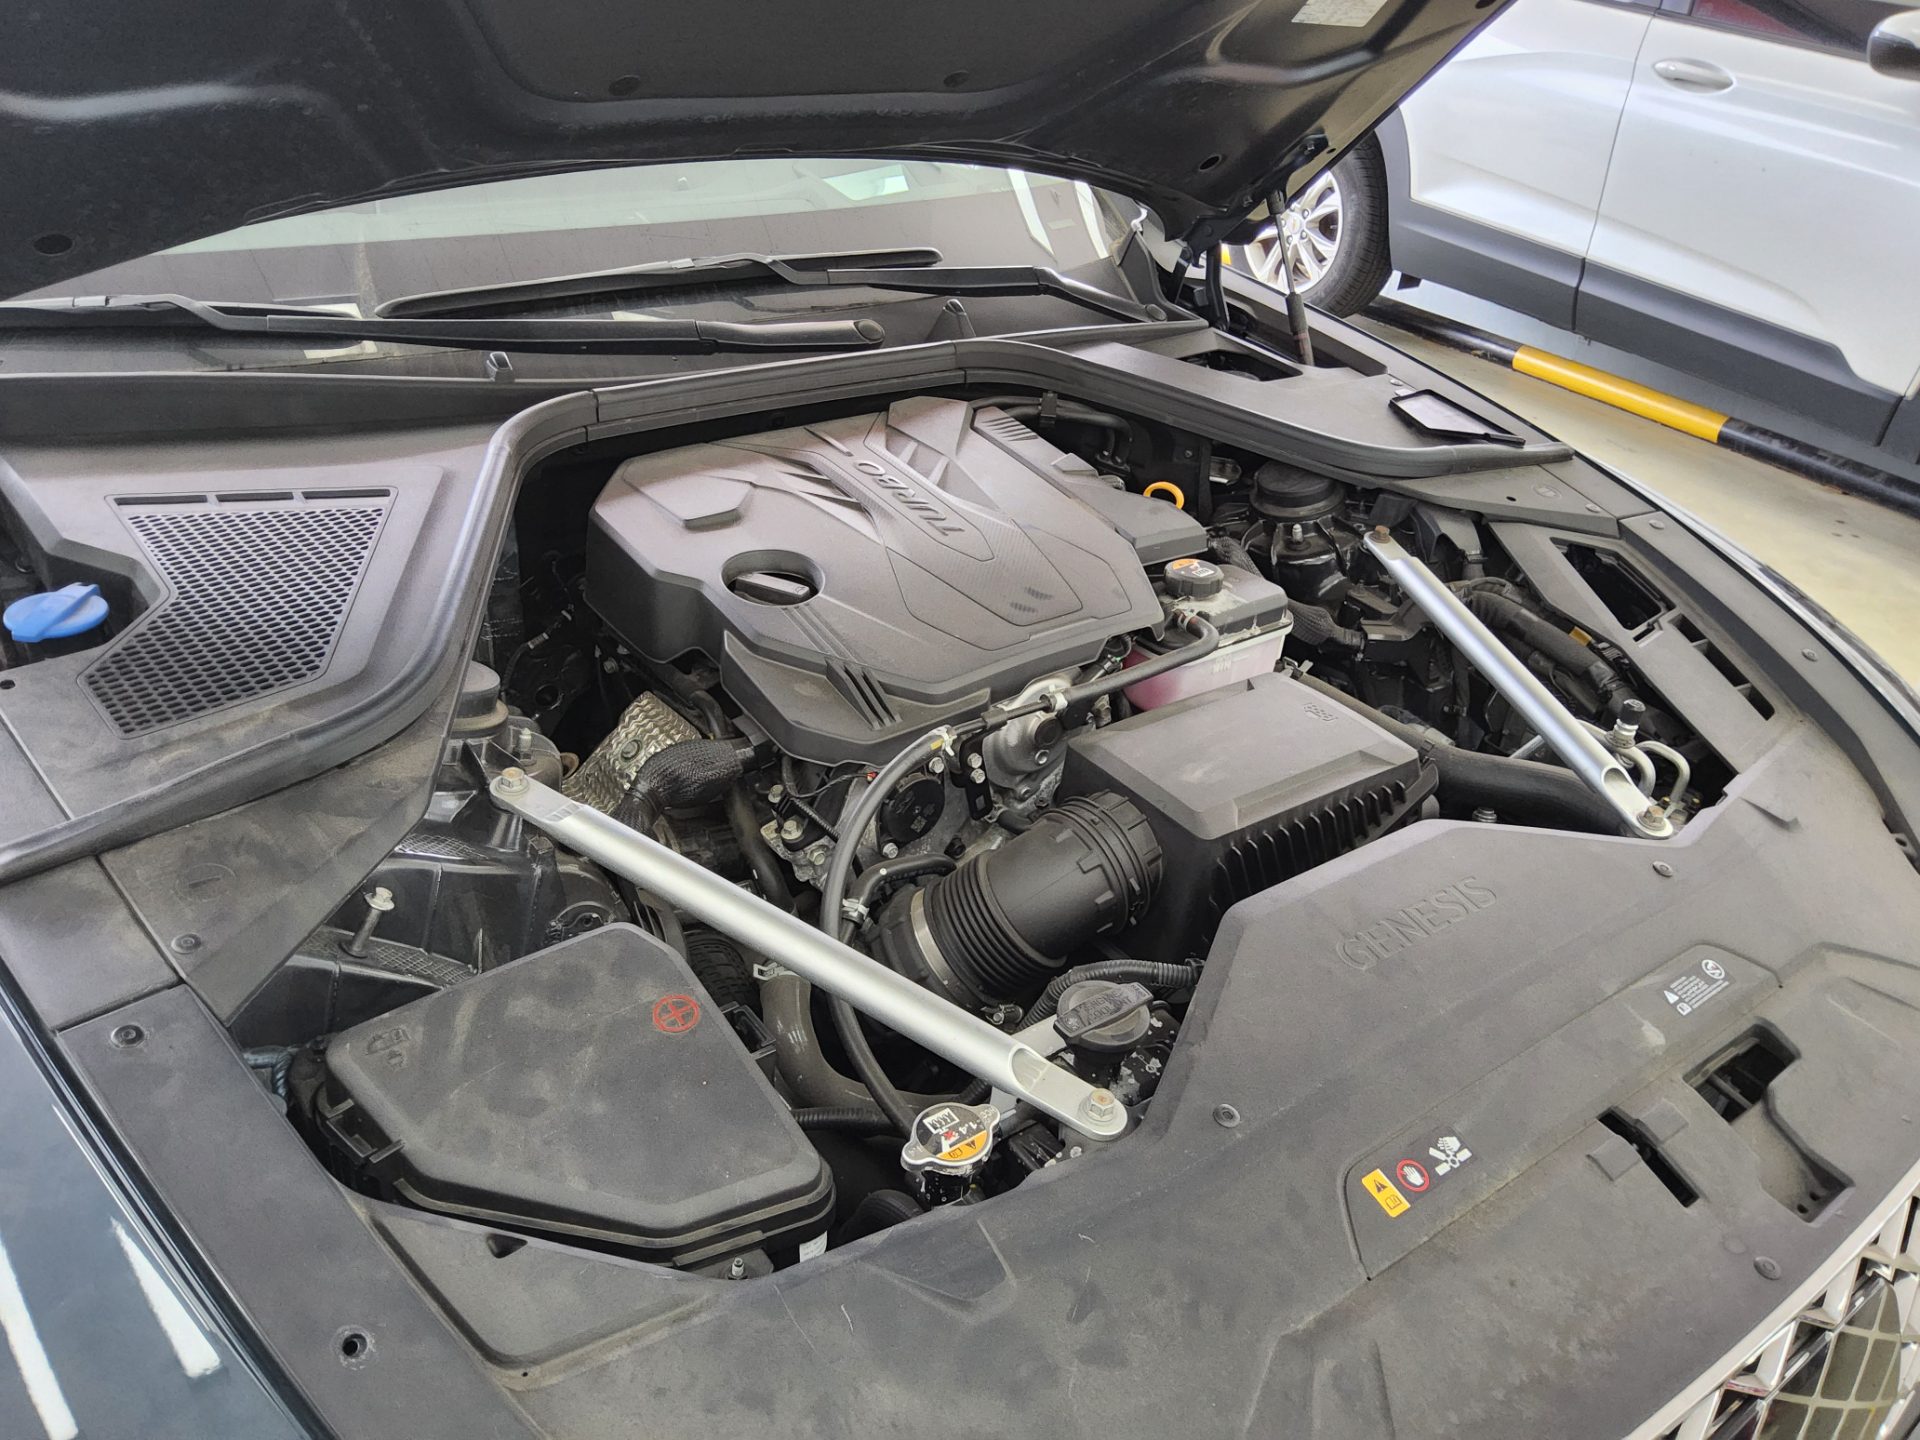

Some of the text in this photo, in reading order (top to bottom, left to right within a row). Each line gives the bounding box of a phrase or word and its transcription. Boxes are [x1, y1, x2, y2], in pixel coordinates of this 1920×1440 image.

[855, 461, 965, 536] TURBO
[1336, 875, 1498, 970] GENESIS
[959, 1121, 978, 1135] 1.4
